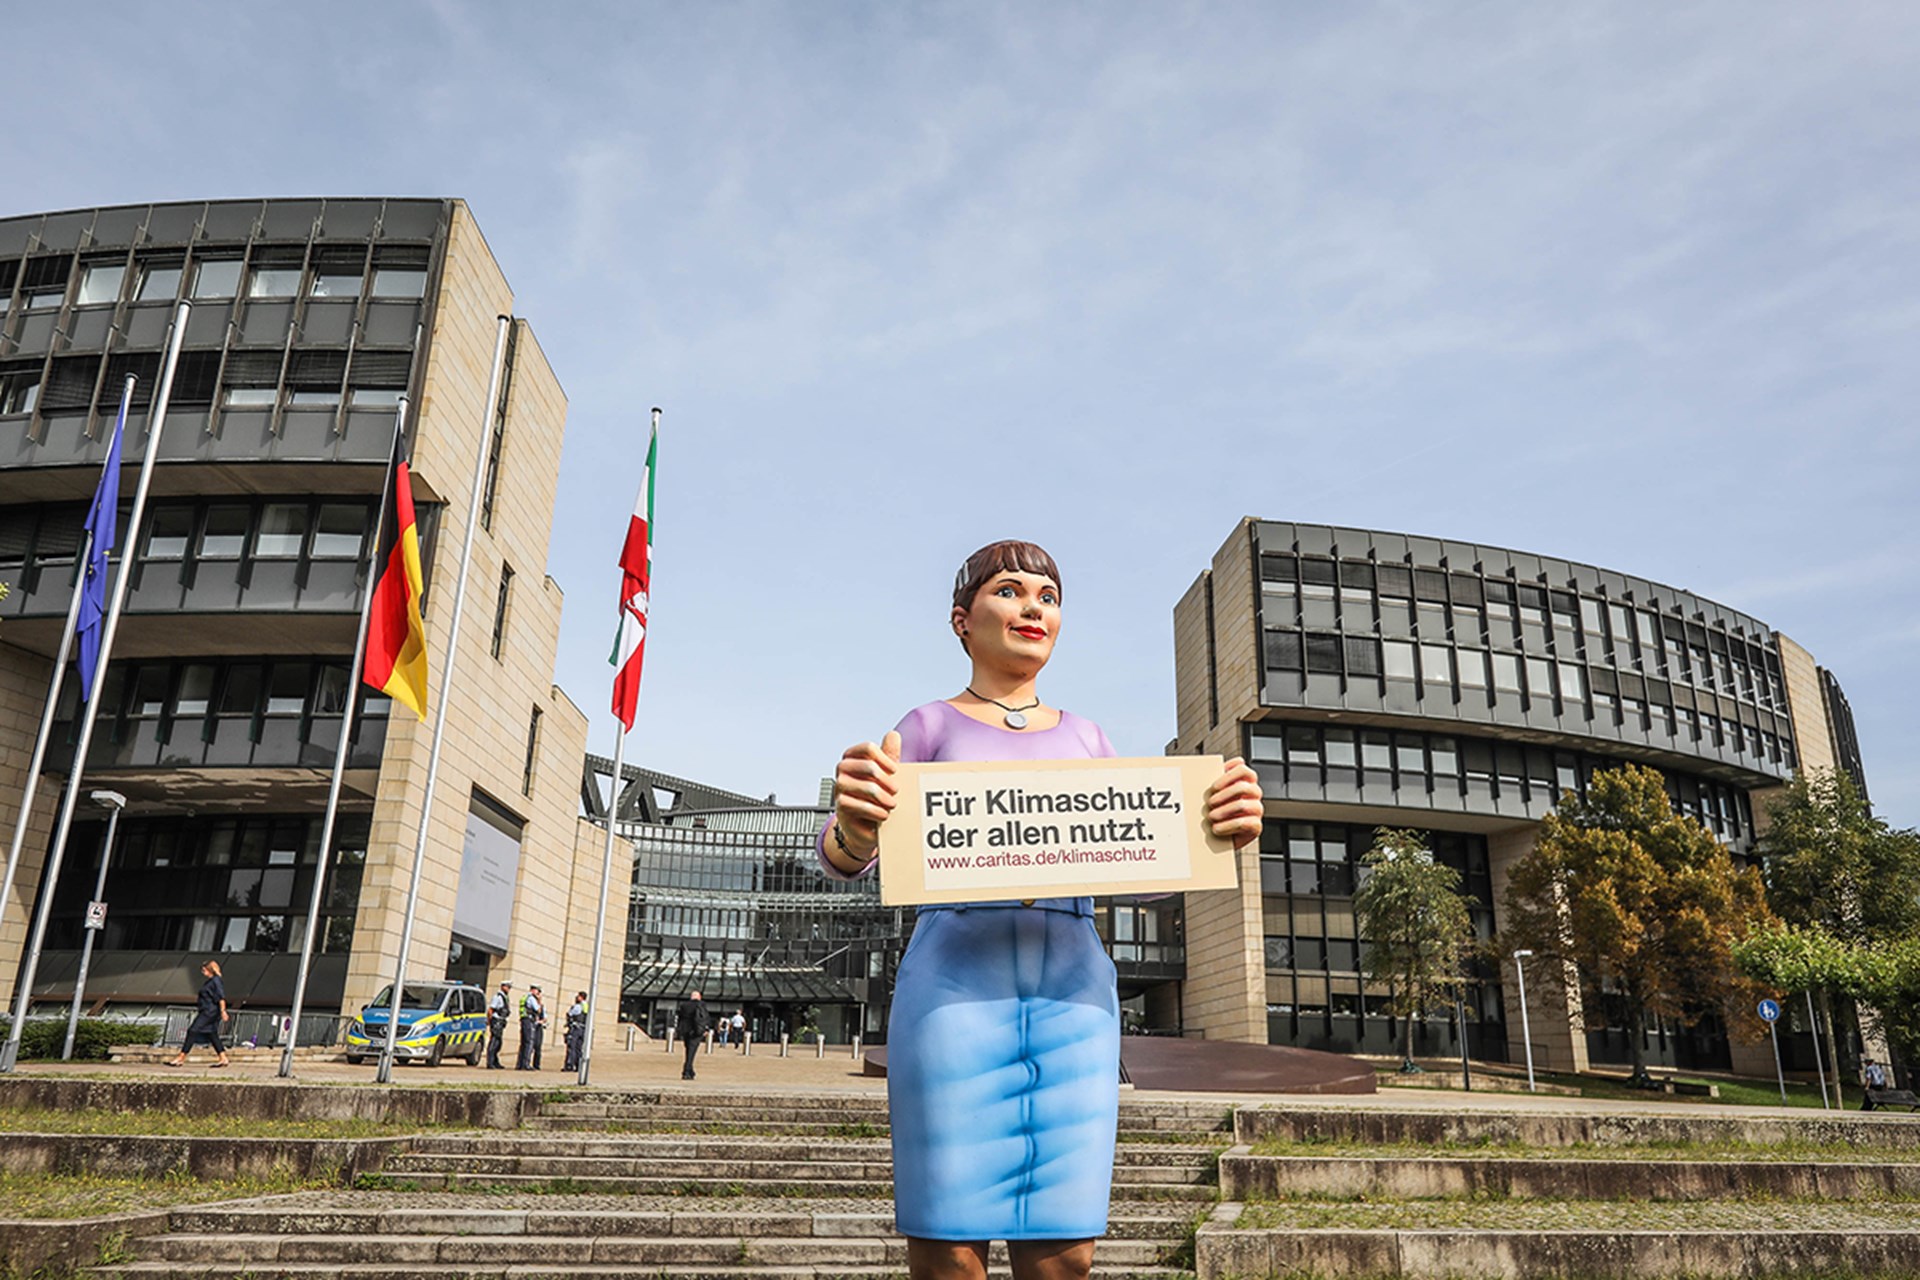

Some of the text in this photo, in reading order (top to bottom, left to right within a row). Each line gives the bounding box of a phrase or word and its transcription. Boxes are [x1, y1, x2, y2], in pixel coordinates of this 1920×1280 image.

[925, 786, 1181, 817] Für Klimaschutz,
[926, 817, 1154, 849] der allen nutzt.
[927, 846, 1157, 870] www.caritas.de/klimaschutz
